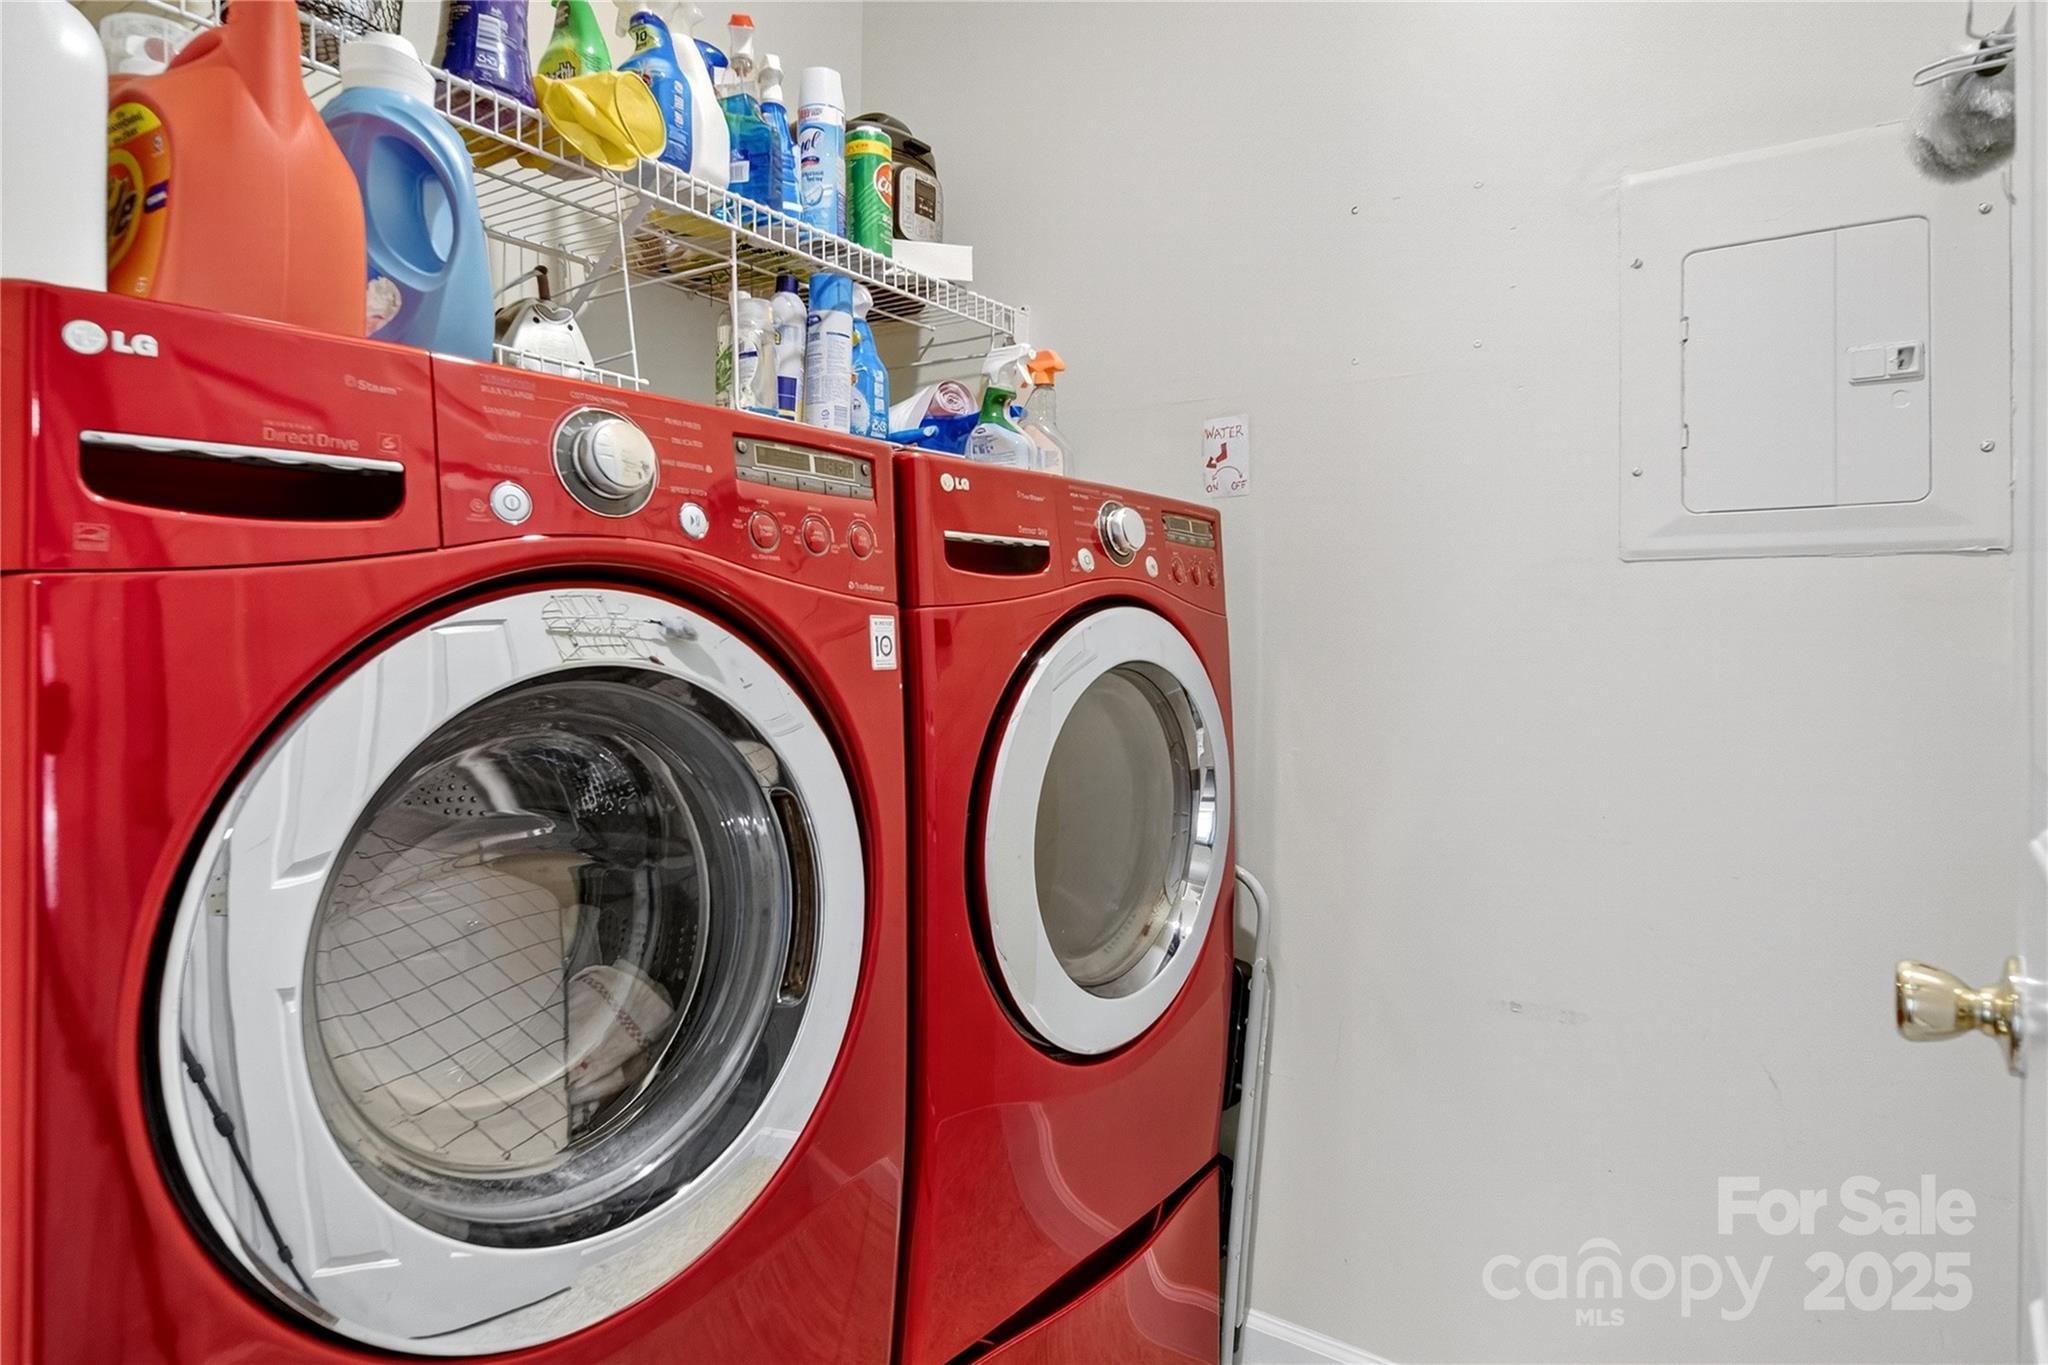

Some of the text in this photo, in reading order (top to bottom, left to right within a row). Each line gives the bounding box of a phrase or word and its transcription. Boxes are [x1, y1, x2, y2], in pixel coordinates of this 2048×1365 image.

[111, 329, 159, 358] LG
[262, 426, 360, 451] Direct Drive
[1204, 424, 1244, 440] WATER
[955, 477, 970, 491] LG
[1205, 479, 1248, 493] ON OFF
[874, 635, 893, 657] 10
